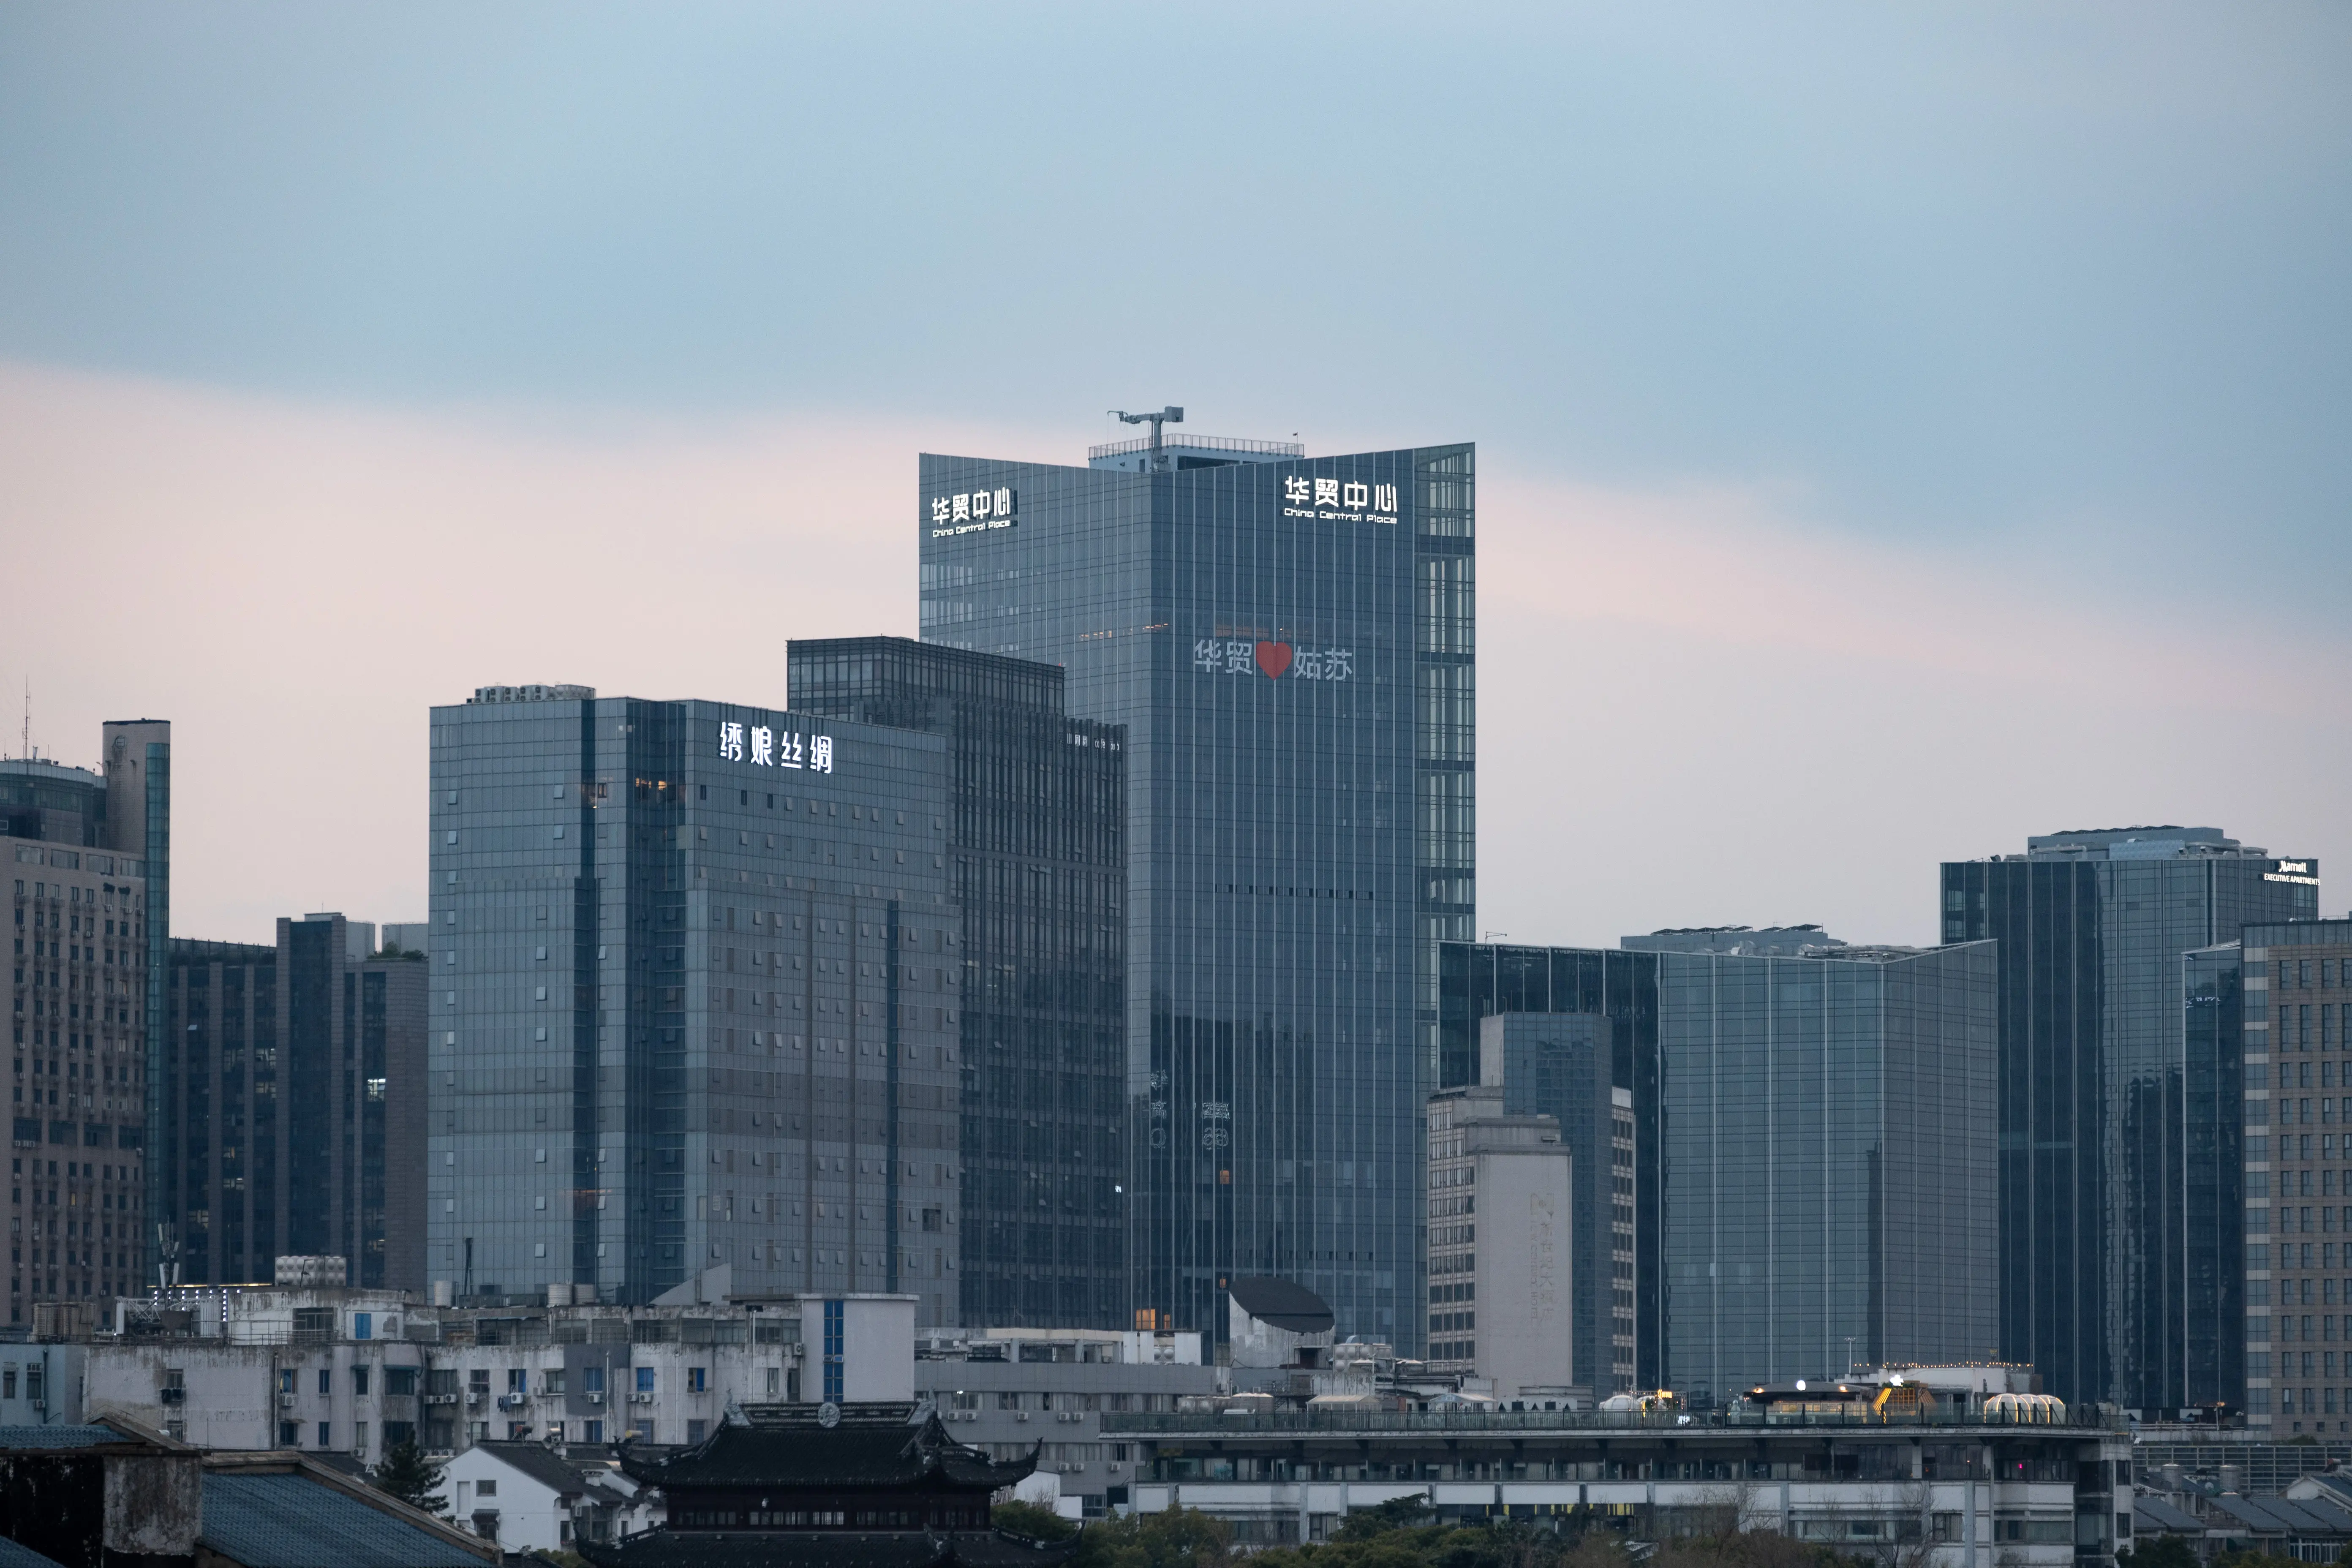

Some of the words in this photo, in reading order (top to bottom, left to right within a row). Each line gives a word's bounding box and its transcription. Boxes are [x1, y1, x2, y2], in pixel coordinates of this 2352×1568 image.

[932, 487, 1010, 525] 华贸中心
[1285, 475, 1397, 512] 华贸中心
[933, 529, 954, 537] China
[956, 523, 985, 534] Central
[988, 520, 1010, 529] Place
[1284, 507, 1314, 518] China
[1320, 510, 1361, 521] Central
[1367, 514, 1397, 524] Place
[1195, 639, 1253, 675] 华贸
[1295, 645, 1353, 681] 姑苏
[720, 721, 832, 774] 绣娘丝绸
[2264, 873, 2290, 882] EXECUTIVE
[2290, 876, 2320, 885] APARTMENTS
[2278, 860, 2307, 873] Marriott
